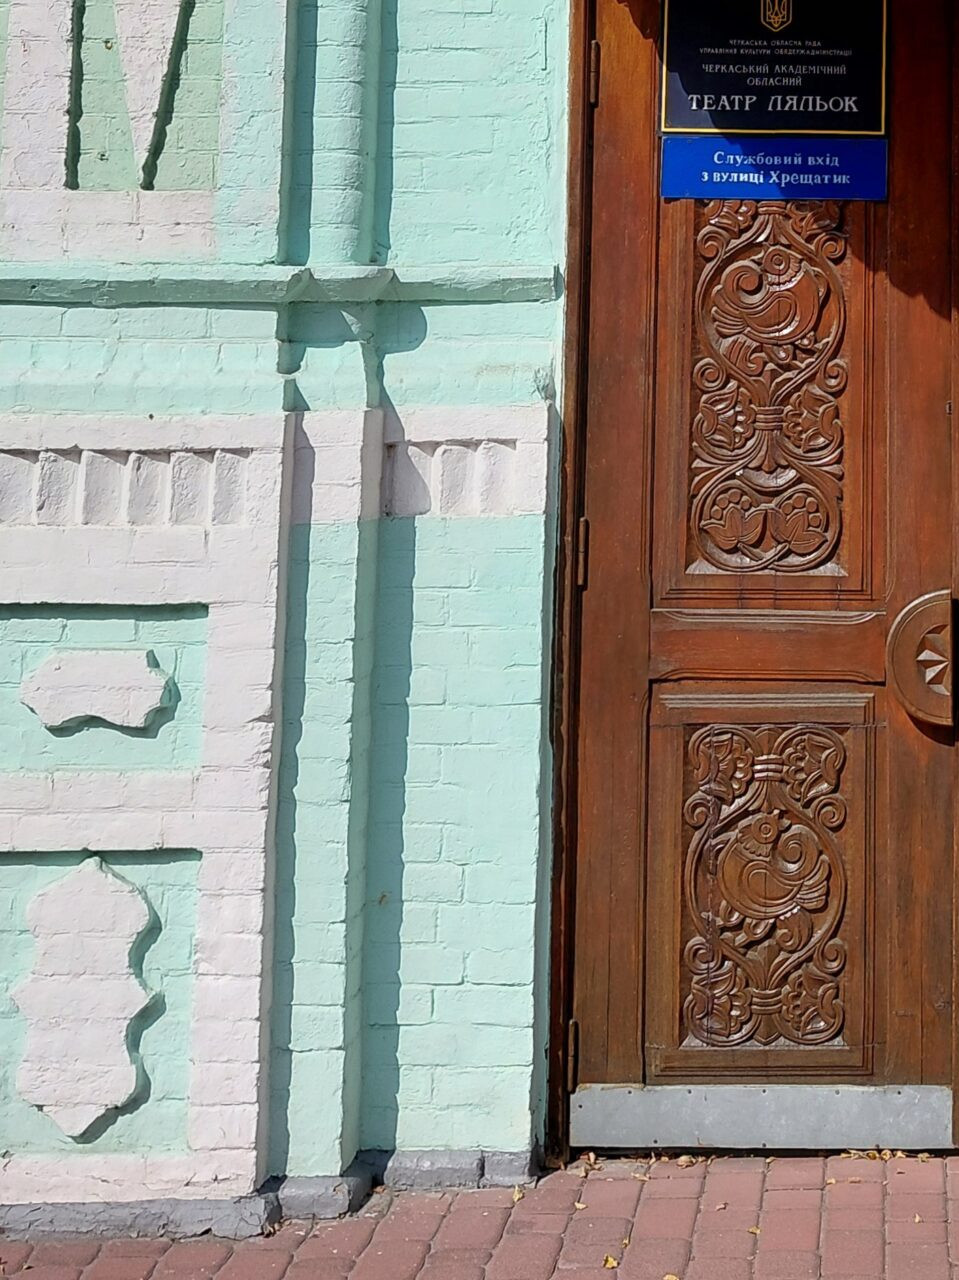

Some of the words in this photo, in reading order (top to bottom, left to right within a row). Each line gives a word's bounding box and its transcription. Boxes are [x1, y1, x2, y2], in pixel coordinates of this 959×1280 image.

[702, 63, 769, 74] ЧЕРКАСЬКИЙ
[773, 64, 847, 75] АКАДЕМІЧНИЙ
[746, 76, 802, 86] ОБЛАСНИЙ
[688, 94, 757, 111] ТЕАТР
[767, 95, 859, 112] ЛЯЛЬОК
[713, 151, 802, 167] Службовий
[807, 153, 840, 167] вхід
[712, 171, 764, 184] вулиці
[768, 171, 850, 187] Хрещатик
